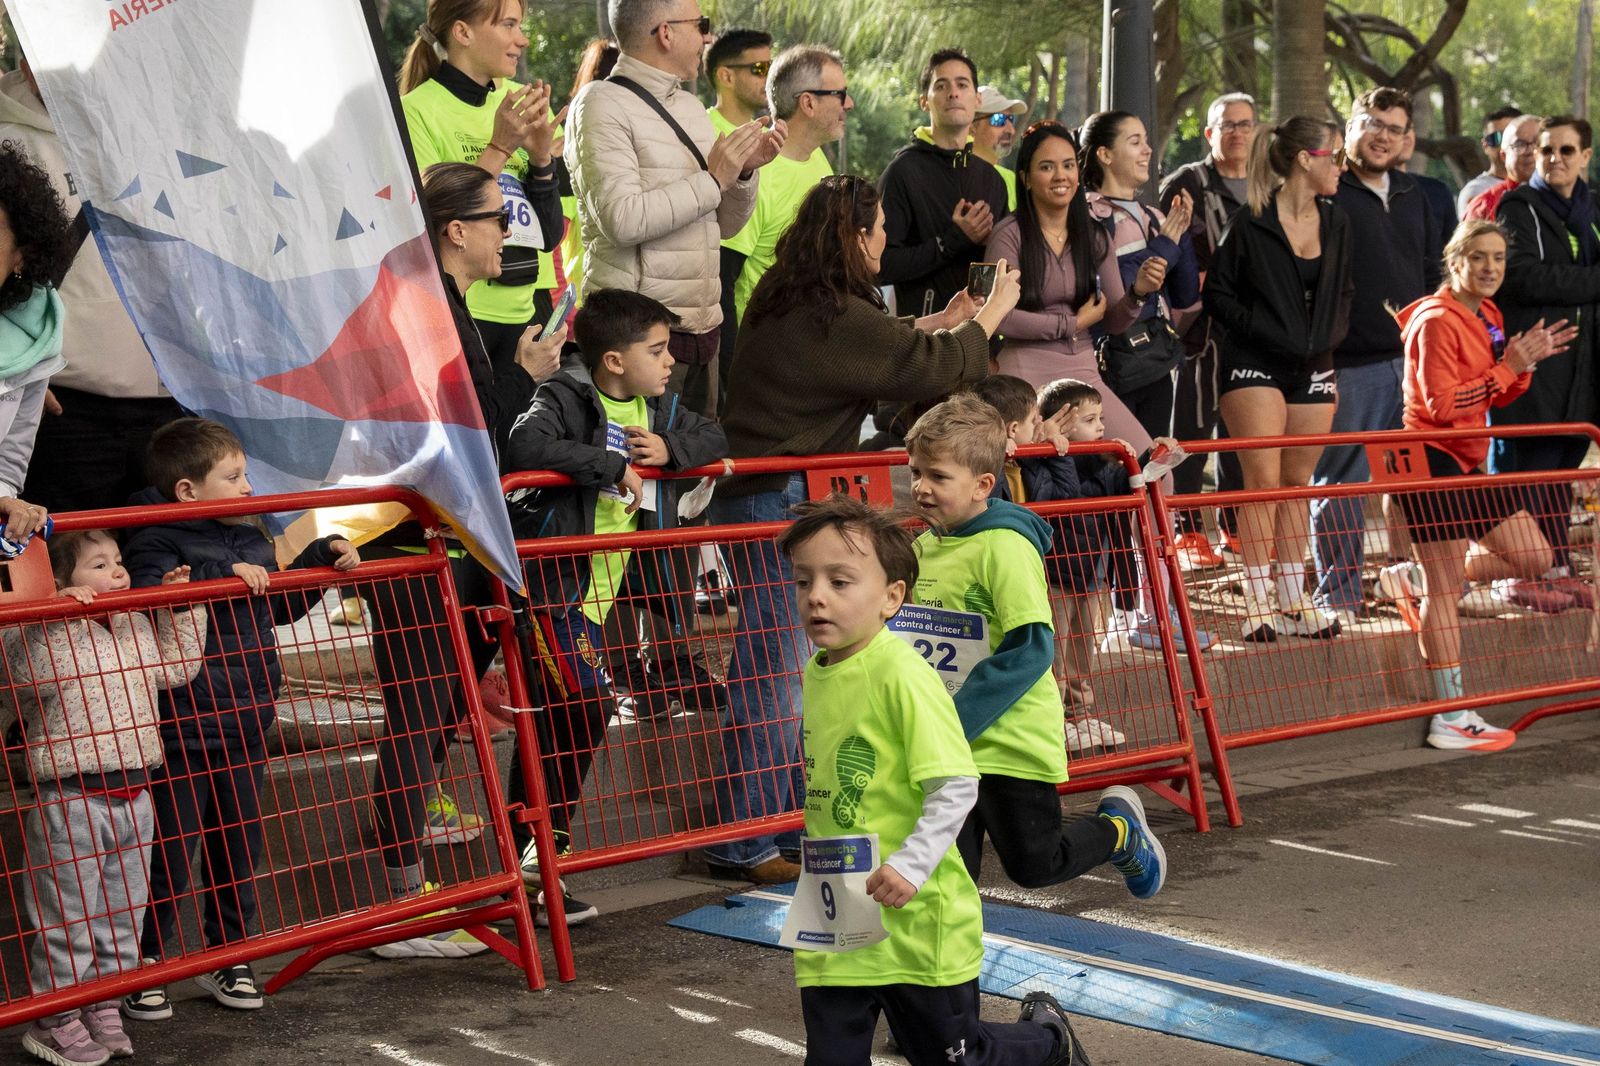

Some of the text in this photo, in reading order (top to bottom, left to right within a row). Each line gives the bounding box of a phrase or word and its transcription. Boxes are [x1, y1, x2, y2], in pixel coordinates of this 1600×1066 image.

[607, 436, 619, 445] ntra
[899, 609, 932, 621] Almería
[895, 620, 923, 629] contra
[925, 622, 933, 631] el
[934, 624, 961, 635] cáncer
[914, 639, 958, 672] 22
[821, 881, 836, 920] 9
